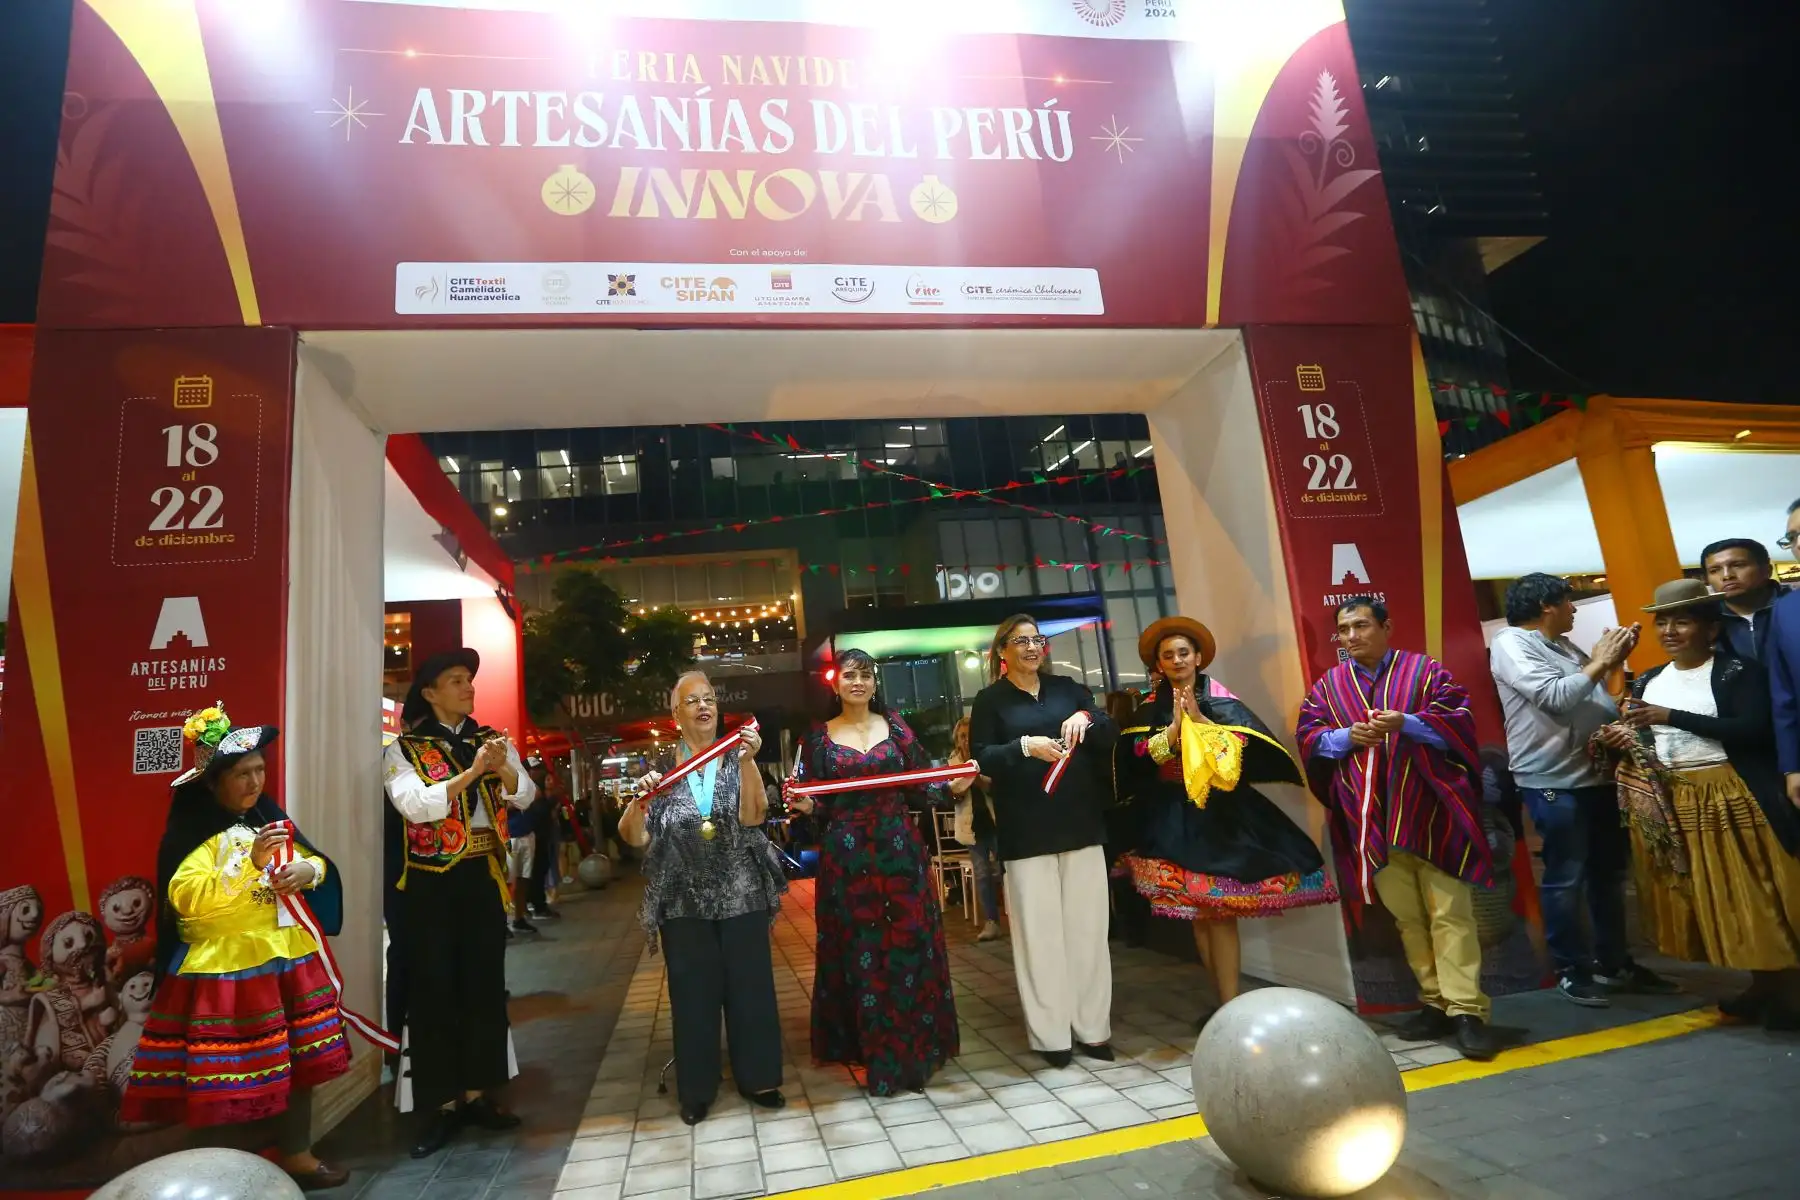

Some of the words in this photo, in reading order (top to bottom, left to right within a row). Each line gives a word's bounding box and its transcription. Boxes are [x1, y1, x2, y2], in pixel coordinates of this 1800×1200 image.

[1145, 8, 1176, 18] 2024
[718, 54, 862, 89] NAVIDE
[398, 86, 796, 155] ARTESANÍAS
[808, 98, 918, 159] DEL
[926, 97, 1074, 162] PERÚ
[607, 167, 903, 222] INNOVA
[729, 248, 748, 257] Con
[751, 248, 760, 257] el
[762, 249, 791, 258] apoyo
[660, 277, 706, 289] CITE
[1297, 403, 1340, 439] 18
[161, 422, 219, 467] 18
[1319, 442, 1330, 451] al
[181, 470, 196, 481] al
[1303, 454, 1357, 490] 22
[1301, 494, 1314, 503] de
[1316, 492, 1368, 502] diciembre
[148, 485, 224, 531] 22
[135, 535, 154, 547] de
[158, 532, 236, 546] diciembre
[130, 656, 226, 676] ARTESANÍAS
[148, 677, 166, 687] DEL
[170, 673, 208, 690] PERÚ
[171, 707, 192, 717] más
